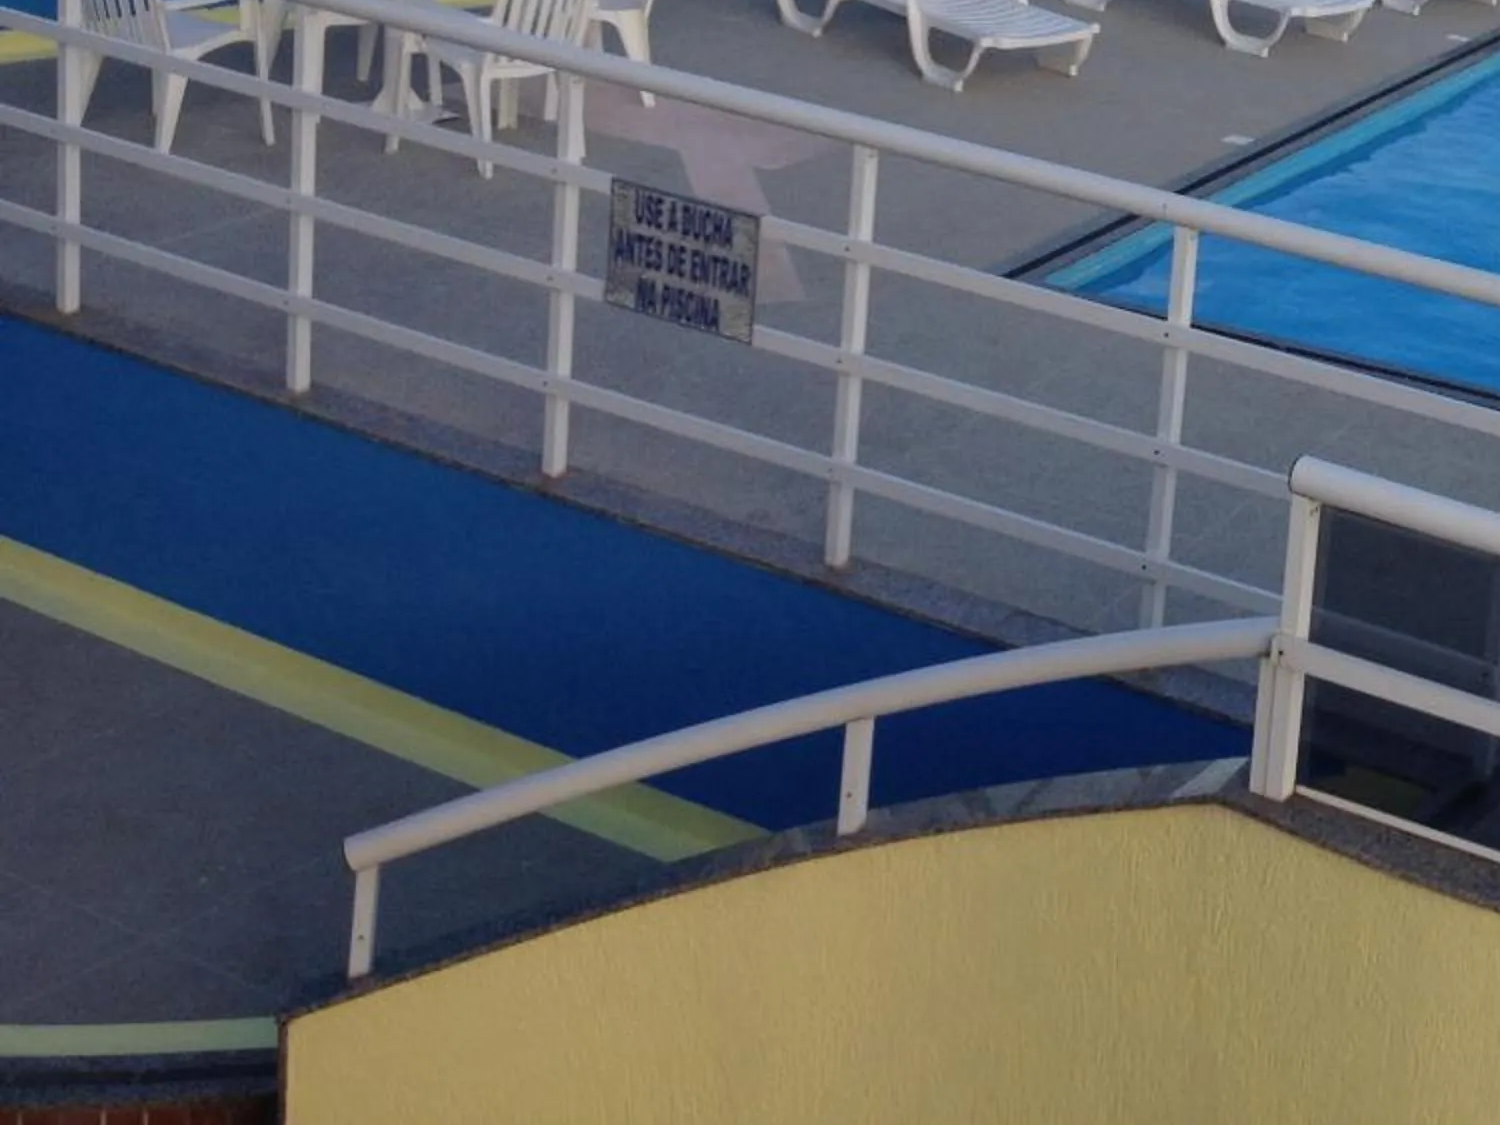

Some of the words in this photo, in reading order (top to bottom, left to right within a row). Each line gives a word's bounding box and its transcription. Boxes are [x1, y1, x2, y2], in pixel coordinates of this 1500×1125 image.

[636, 187, 664, 229] USE
[668, 199, 678, 232] A
[615, 228, 663, 271] ANTES
[667, 242, 687, 278] DE
[691, 249, 750, 297] ENTRAR
[636, 277, 656, 313] NA
[661, 283, 719, 332] PISCINA
